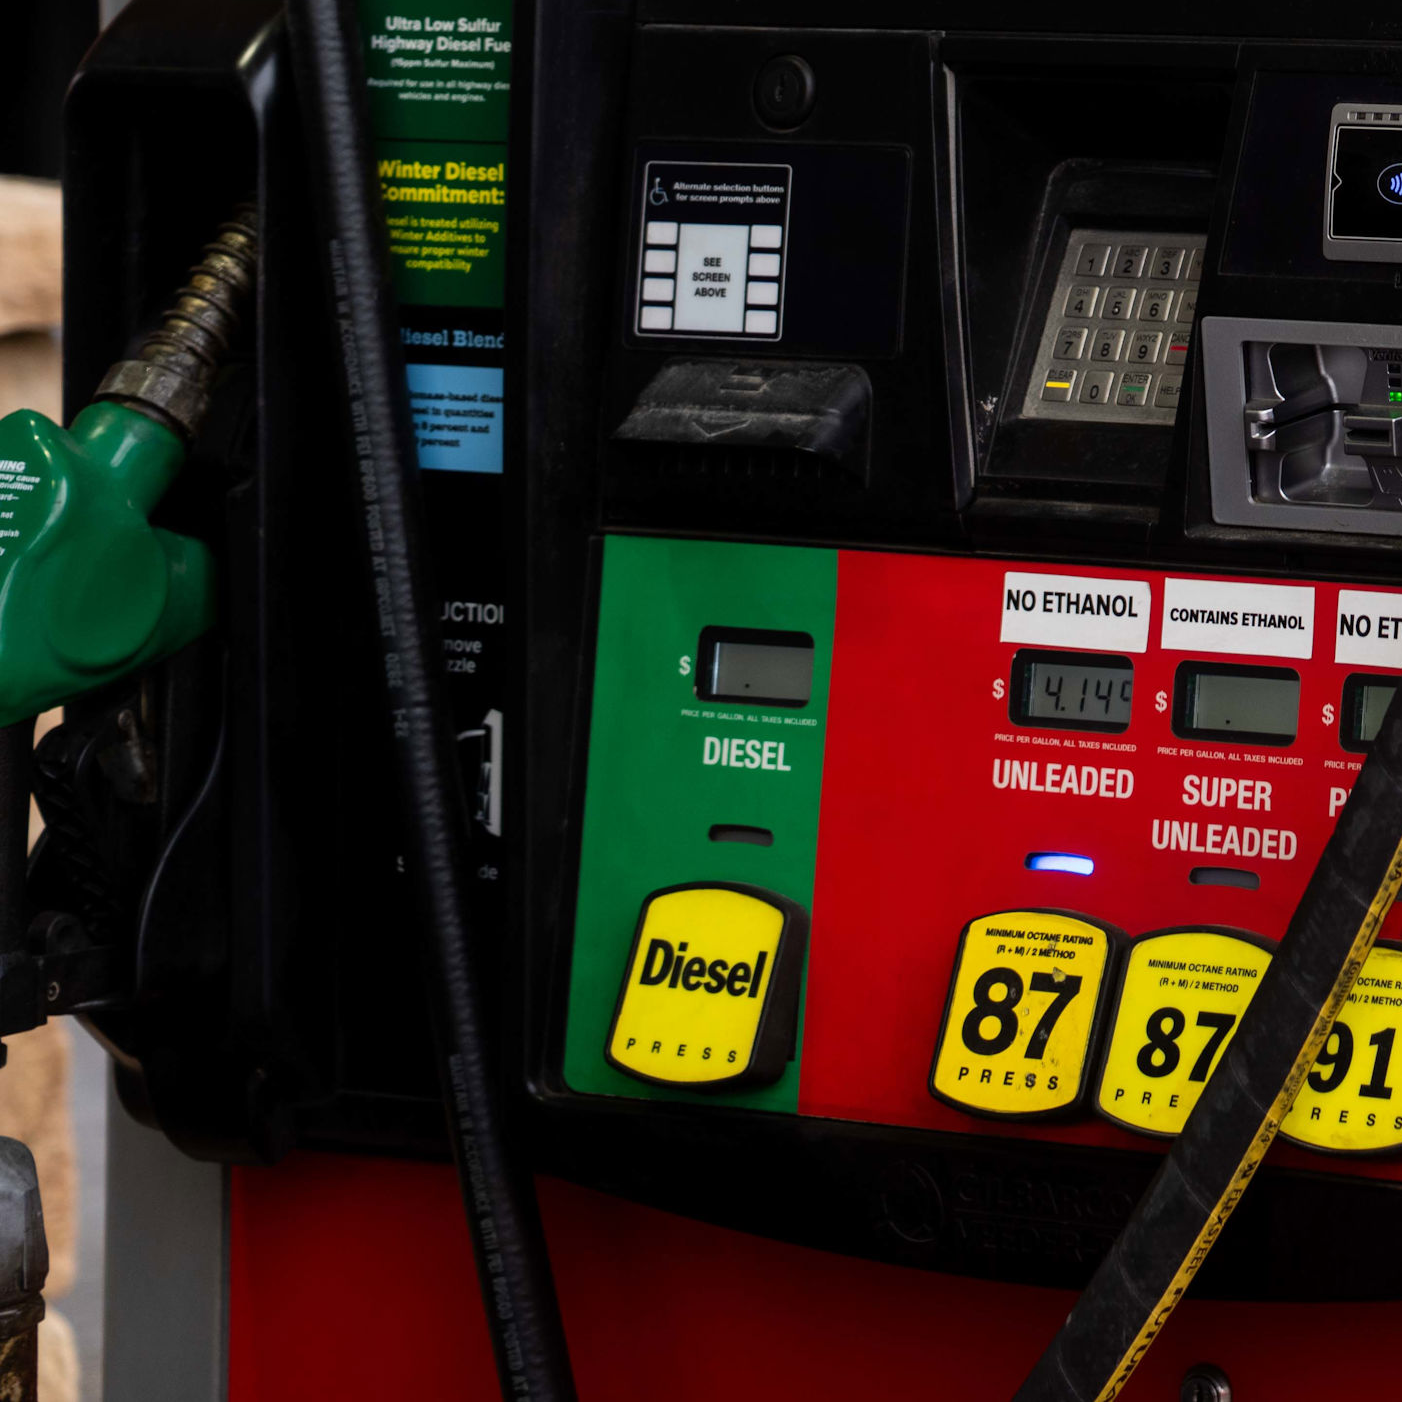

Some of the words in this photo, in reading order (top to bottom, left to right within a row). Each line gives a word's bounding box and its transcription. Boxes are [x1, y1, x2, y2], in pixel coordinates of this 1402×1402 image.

[385, 16, 421, 31] Ultra
[425, 17, 454, 32] Low
[457, 17, 501, 33] Sulfur
[371, 35, 433, 54] Highway
[437, 37, 481, 51] Diesel
[445, 163, 504, 182] Diesel
[673, 182, 712, 191] Alternate
[713, 182, 751, 192] selection
[753, 184, 784, 193] buttons
[676, 193, 689, 202] for
[690, 194, 717, 202] screen
[720, 195, 753, 204] prompts
[756, 195, 780, 204] above
[703, 257, 722, 267] SEE
[692, 272, 731, 283] SCREEN
[694, 287, 726, 298] ABOVE
[1049, 370, 1073, 380] CLEAR
[1123, 374, 1149, 384] ENTER
[1006, 588, 1036, 613] NO
[1042, 591, 1138, 618] ETHANOL
[1170, 608, 1238, 625] CONTAINS
[1242, 613, 1305, 631] ETHANOL
[703, 736, 791, 772] DIESEL
[992, 758, 1134, 799] UNLEADED
[1182, 774, 1272, 811] SUPER
[1152, 819, 1297, 860] UNLEADED
[639, 937, 769, 999] Diesel
[1148, 959, 1186, 971] MINIMUM
[1189, 964, 1223, 974] OCTANE
[1226, 966, 1257, 978] RATING
[1201, 982, 1239, 993] METHOD
[959, 965, 1082, 1061] 87
[1137, 1006, 1237, 1083] 87
[1307, 1021, 1396, 1099] 91
